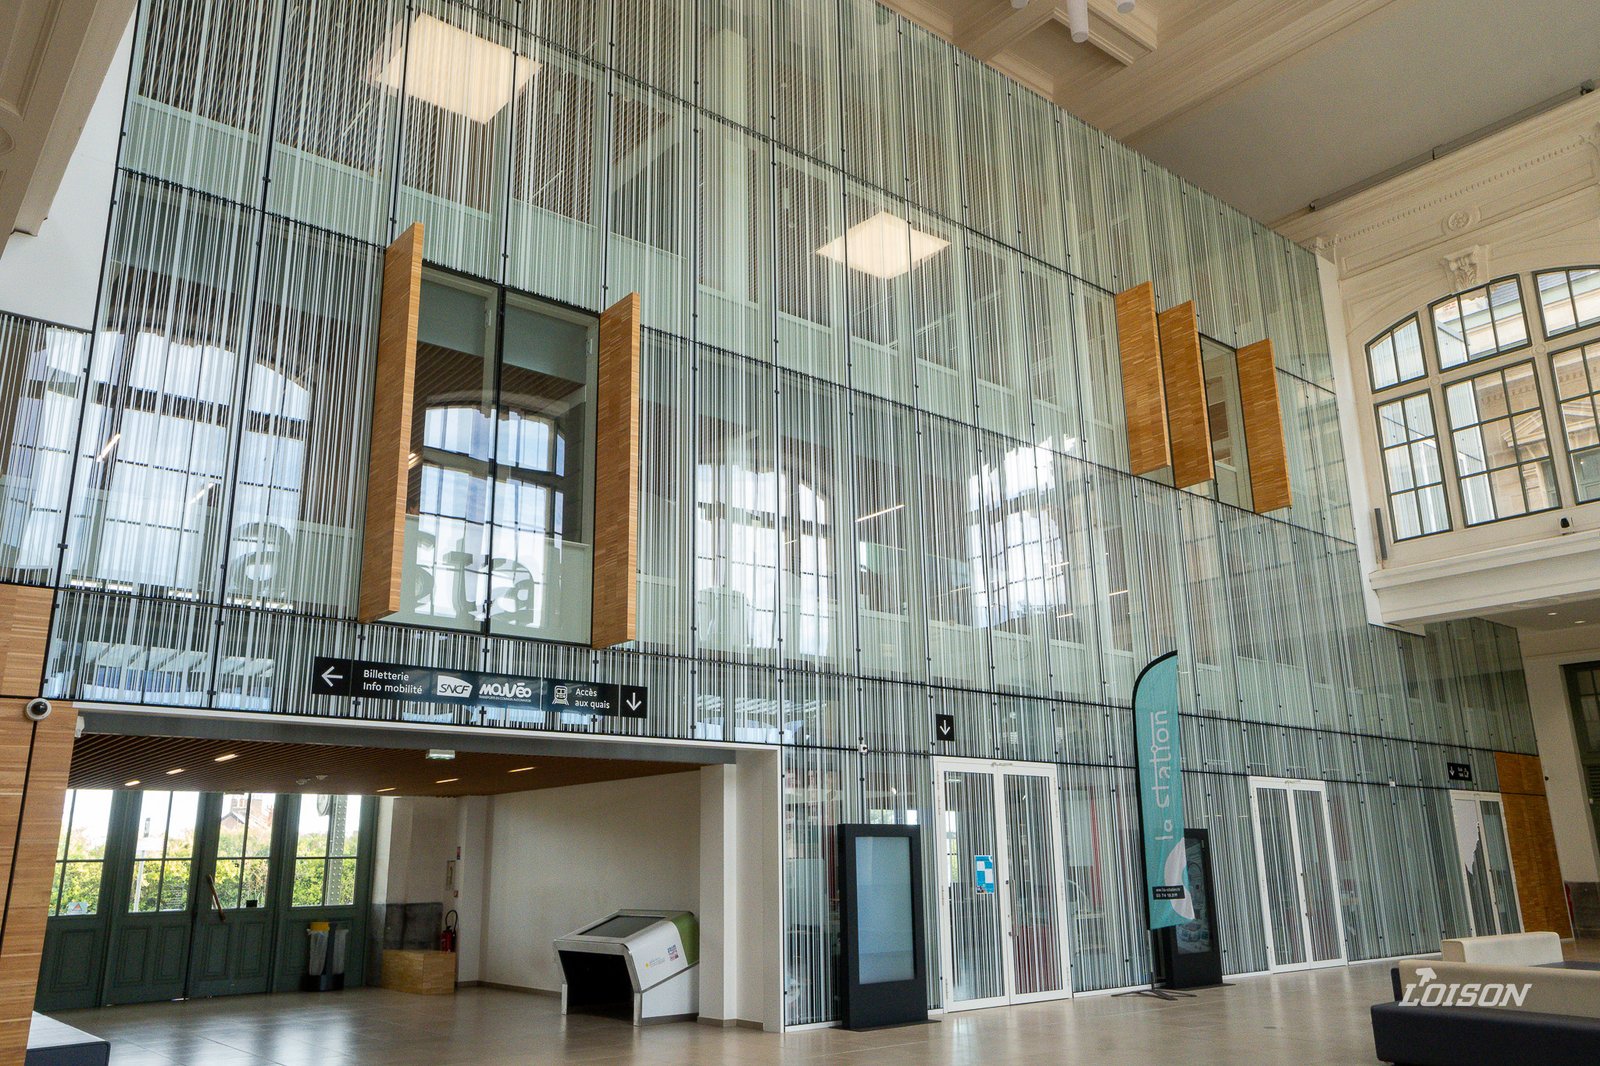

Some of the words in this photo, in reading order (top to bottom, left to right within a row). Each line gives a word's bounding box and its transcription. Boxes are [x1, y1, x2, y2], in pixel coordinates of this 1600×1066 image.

[363, 669, 409, 681] Billetterie
[363, 681, 382, 692] Info
[384, 684, 423, 694] mobilité
[438, 683, 470, 694] SNCF
[575, 688, 598, 697] Accès
[590, 700, 611, 710] quais
[1149, 710, 1172, 808] station
[1155, 819, 1174, 841] la
